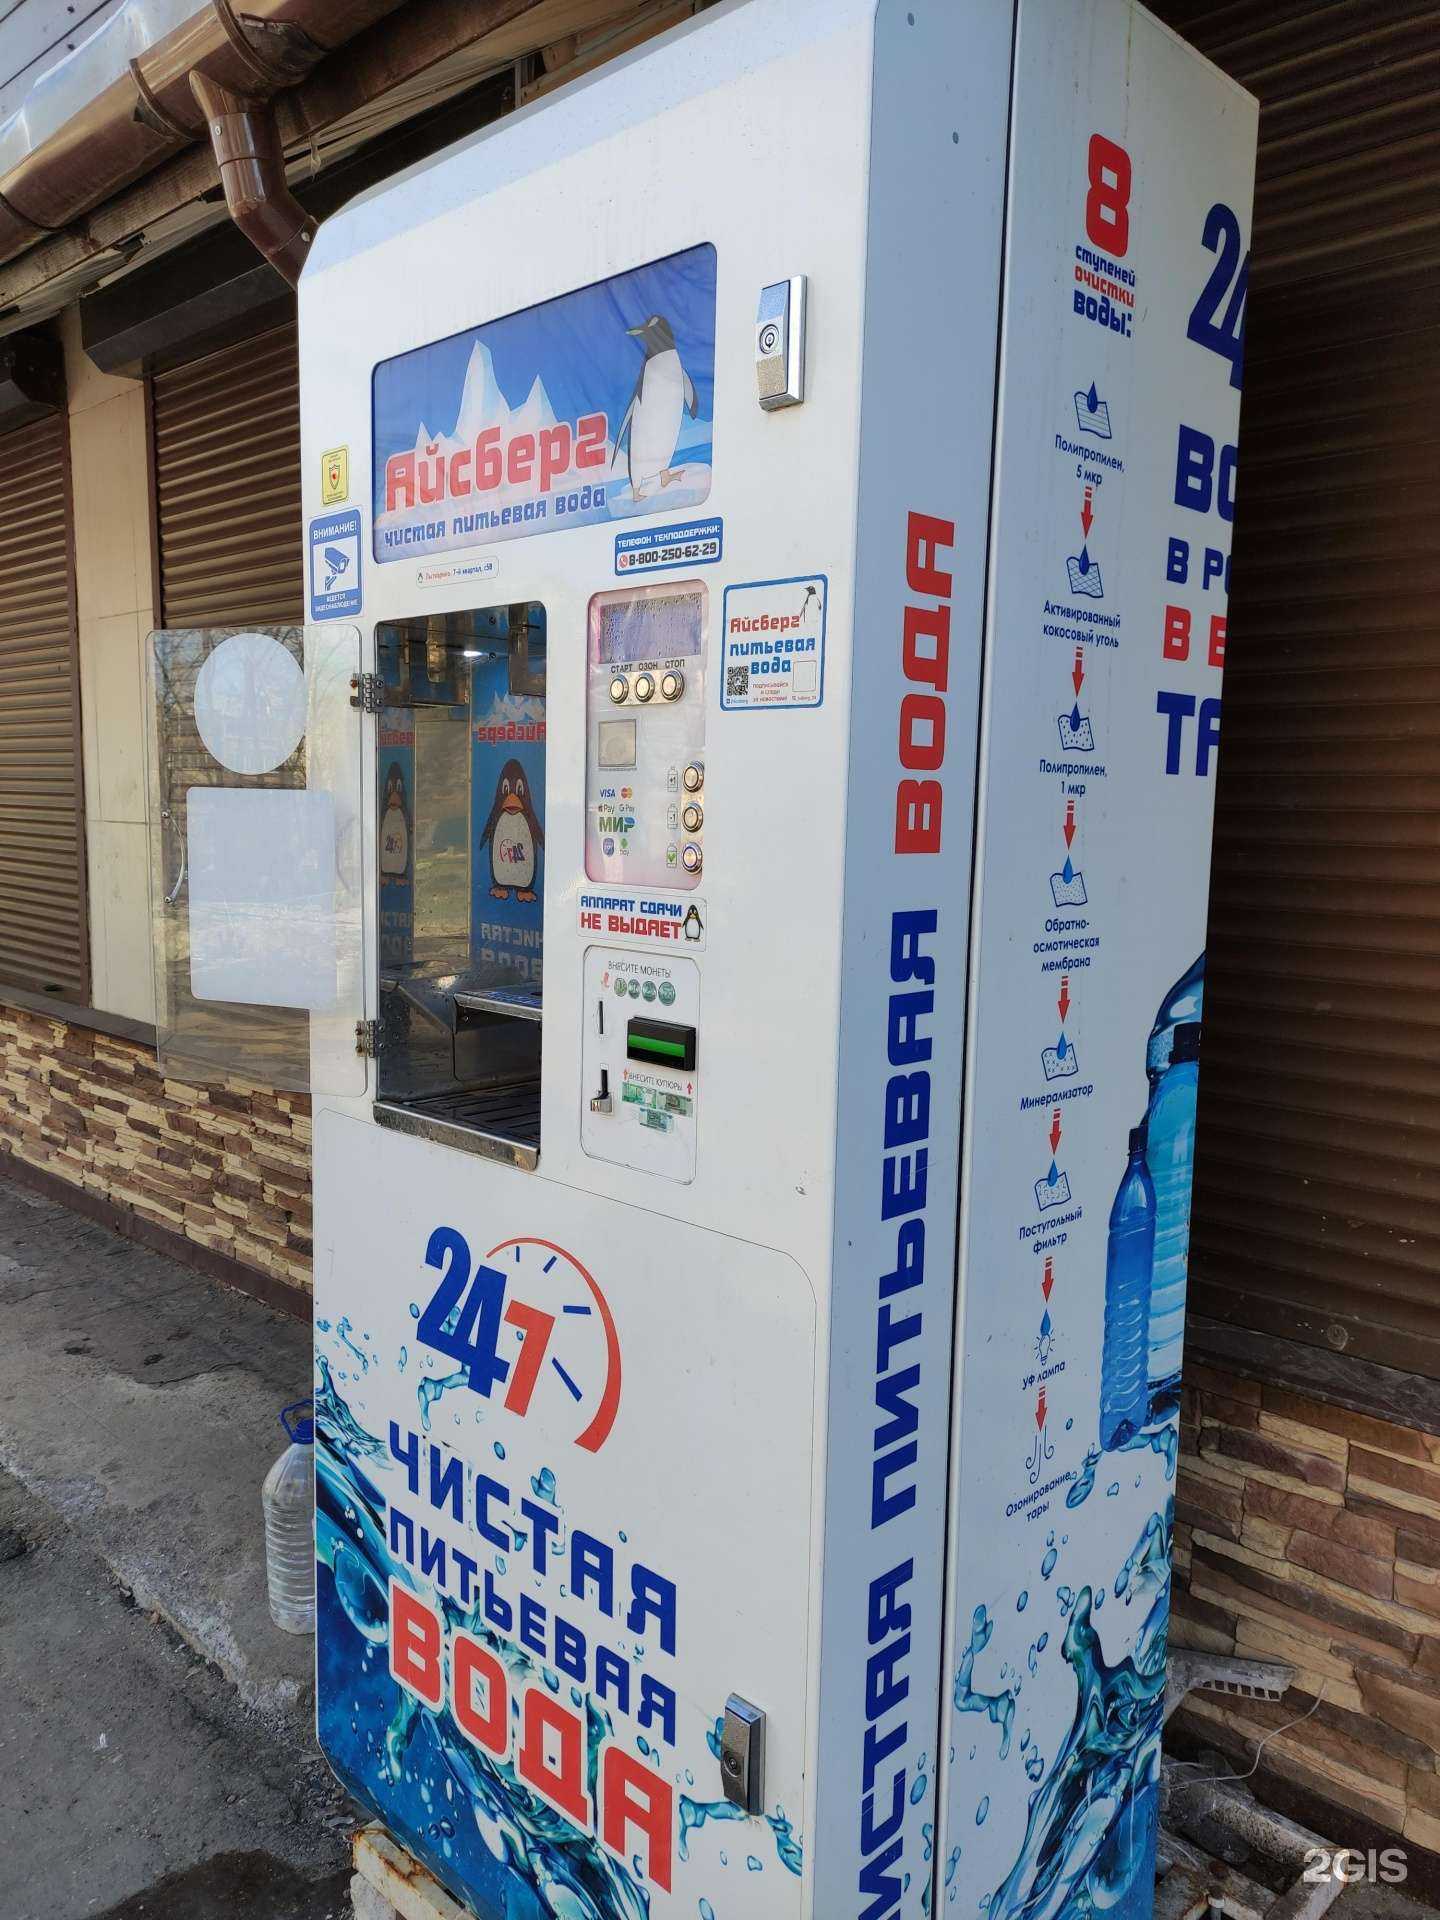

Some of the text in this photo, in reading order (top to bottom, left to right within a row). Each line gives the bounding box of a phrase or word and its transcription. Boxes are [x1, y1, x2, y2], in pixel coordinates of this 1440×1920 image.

[1086, 133, 1132, 258] 8
[1075, 245, 1136, 288] ступеней
[1074, 265, 1135, 308] очистки
[1073, 290, 1132, 338] воды:
[386, 415, 607, 512] Айсберг
[1055, 434, 1125, 473] Полипропилен,
[1076, 464, 1102, 486] 5 мкр
[385, 485, 606, 547] чистая питьевая вода
[313, 520, 357, 540] ВНИМАНИЕ!
[618, 536, 652, 548] ТЕЛЕФОН
[629, 541, 717, 566] 8-800-250-62-29
[1166, 537, 1231, 594] В Р
[730, 614, 800, 634] Айсберг
[1044, 600, 1121, 629] Активированный
[1043, 623, 1119, 649] кокосовый уголь
[1163, 604, 1191, 662] В
[729, 638, 816, 657] питьевая
[611, 659, 685, 673] СТАРТ ОЗОН СТОП
[750, 656, 791, 674] вода
[895, 511, 955, 854] ВОДА
[1039, 759, 1108, 777] Полипропилен,
[600, 789, 615, 797] VISA
[1068, 784, 1086, 798] мкр
[599, 816, 636, 833] МИР
[581, 896, 682, 917] АППАРАТ СДАЧИ
[581, 912, 682, 939] НЕ ВЫДАЕТ
[1045, 918, 1089, 934] Обратно-
[1033, 935, 1100, 954] осмотическая
[608, 961, 671, 978] ВНЕСИТЕ МОНЕТЫ
[1041, 956, 1091, 973] мембрана
[1020, 1083, 1093, 1111] Минерализатор
[871, 909, 938, 1530] ПИТЬЕВАЯ
[1019, 1206, 1082, 1241] Постугольный
[1033, 1231, 1067, 1255] фильтр
[1037, 1359, 1065, 1383] лампа
[1006, 1472, 1070, 1518] Озонирование
[1026, 1501, 1049, 1523] тары
[390, 1421, 676, 1657] ЧИСТАЯ
[390, 1506, 676, 1747] ПИТЬЕВАЯ
[391, 1582, 672, 1895] ВОДА
[857, 1556, 914, 1920] ИСТАЯ
